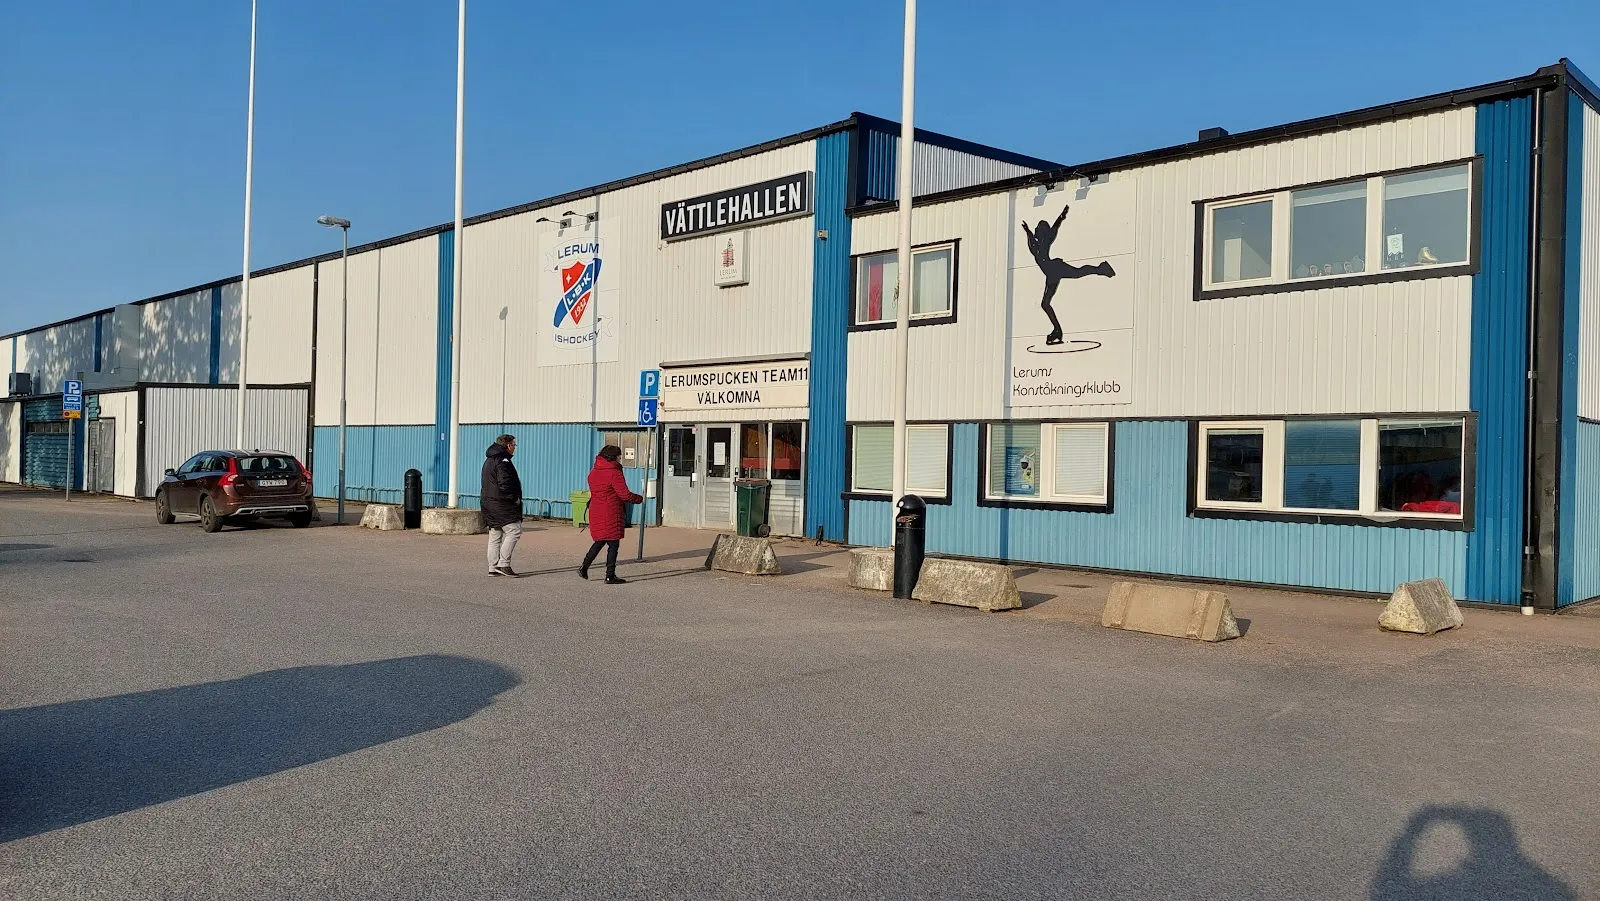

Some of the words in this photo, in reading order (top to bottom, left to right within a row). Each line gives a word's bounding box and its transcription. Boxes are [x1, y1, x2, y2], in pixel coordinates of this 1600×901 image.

[665, 181, 802, 235] VÄTTLEHALLEN
[557, 243, 600, 260] LERUM
[719, 268, 738, 276] LERUM
[573, 297, 587, 318] 1932
[554, 328, 601, 344] ISHOCKEY
[664, 371, 758, 388] LERUMSPUCKEN
[762, 367, 808, 383] TEAM11
[1013, 366, 1053, 378] Lerums
[68, 381, 79, 394] P
[645, 372, 655, 395] P
[1013, 380, 1121, 398] Konståkningsklubb
[697, 390, 761, 405] VÄLKOMNA
